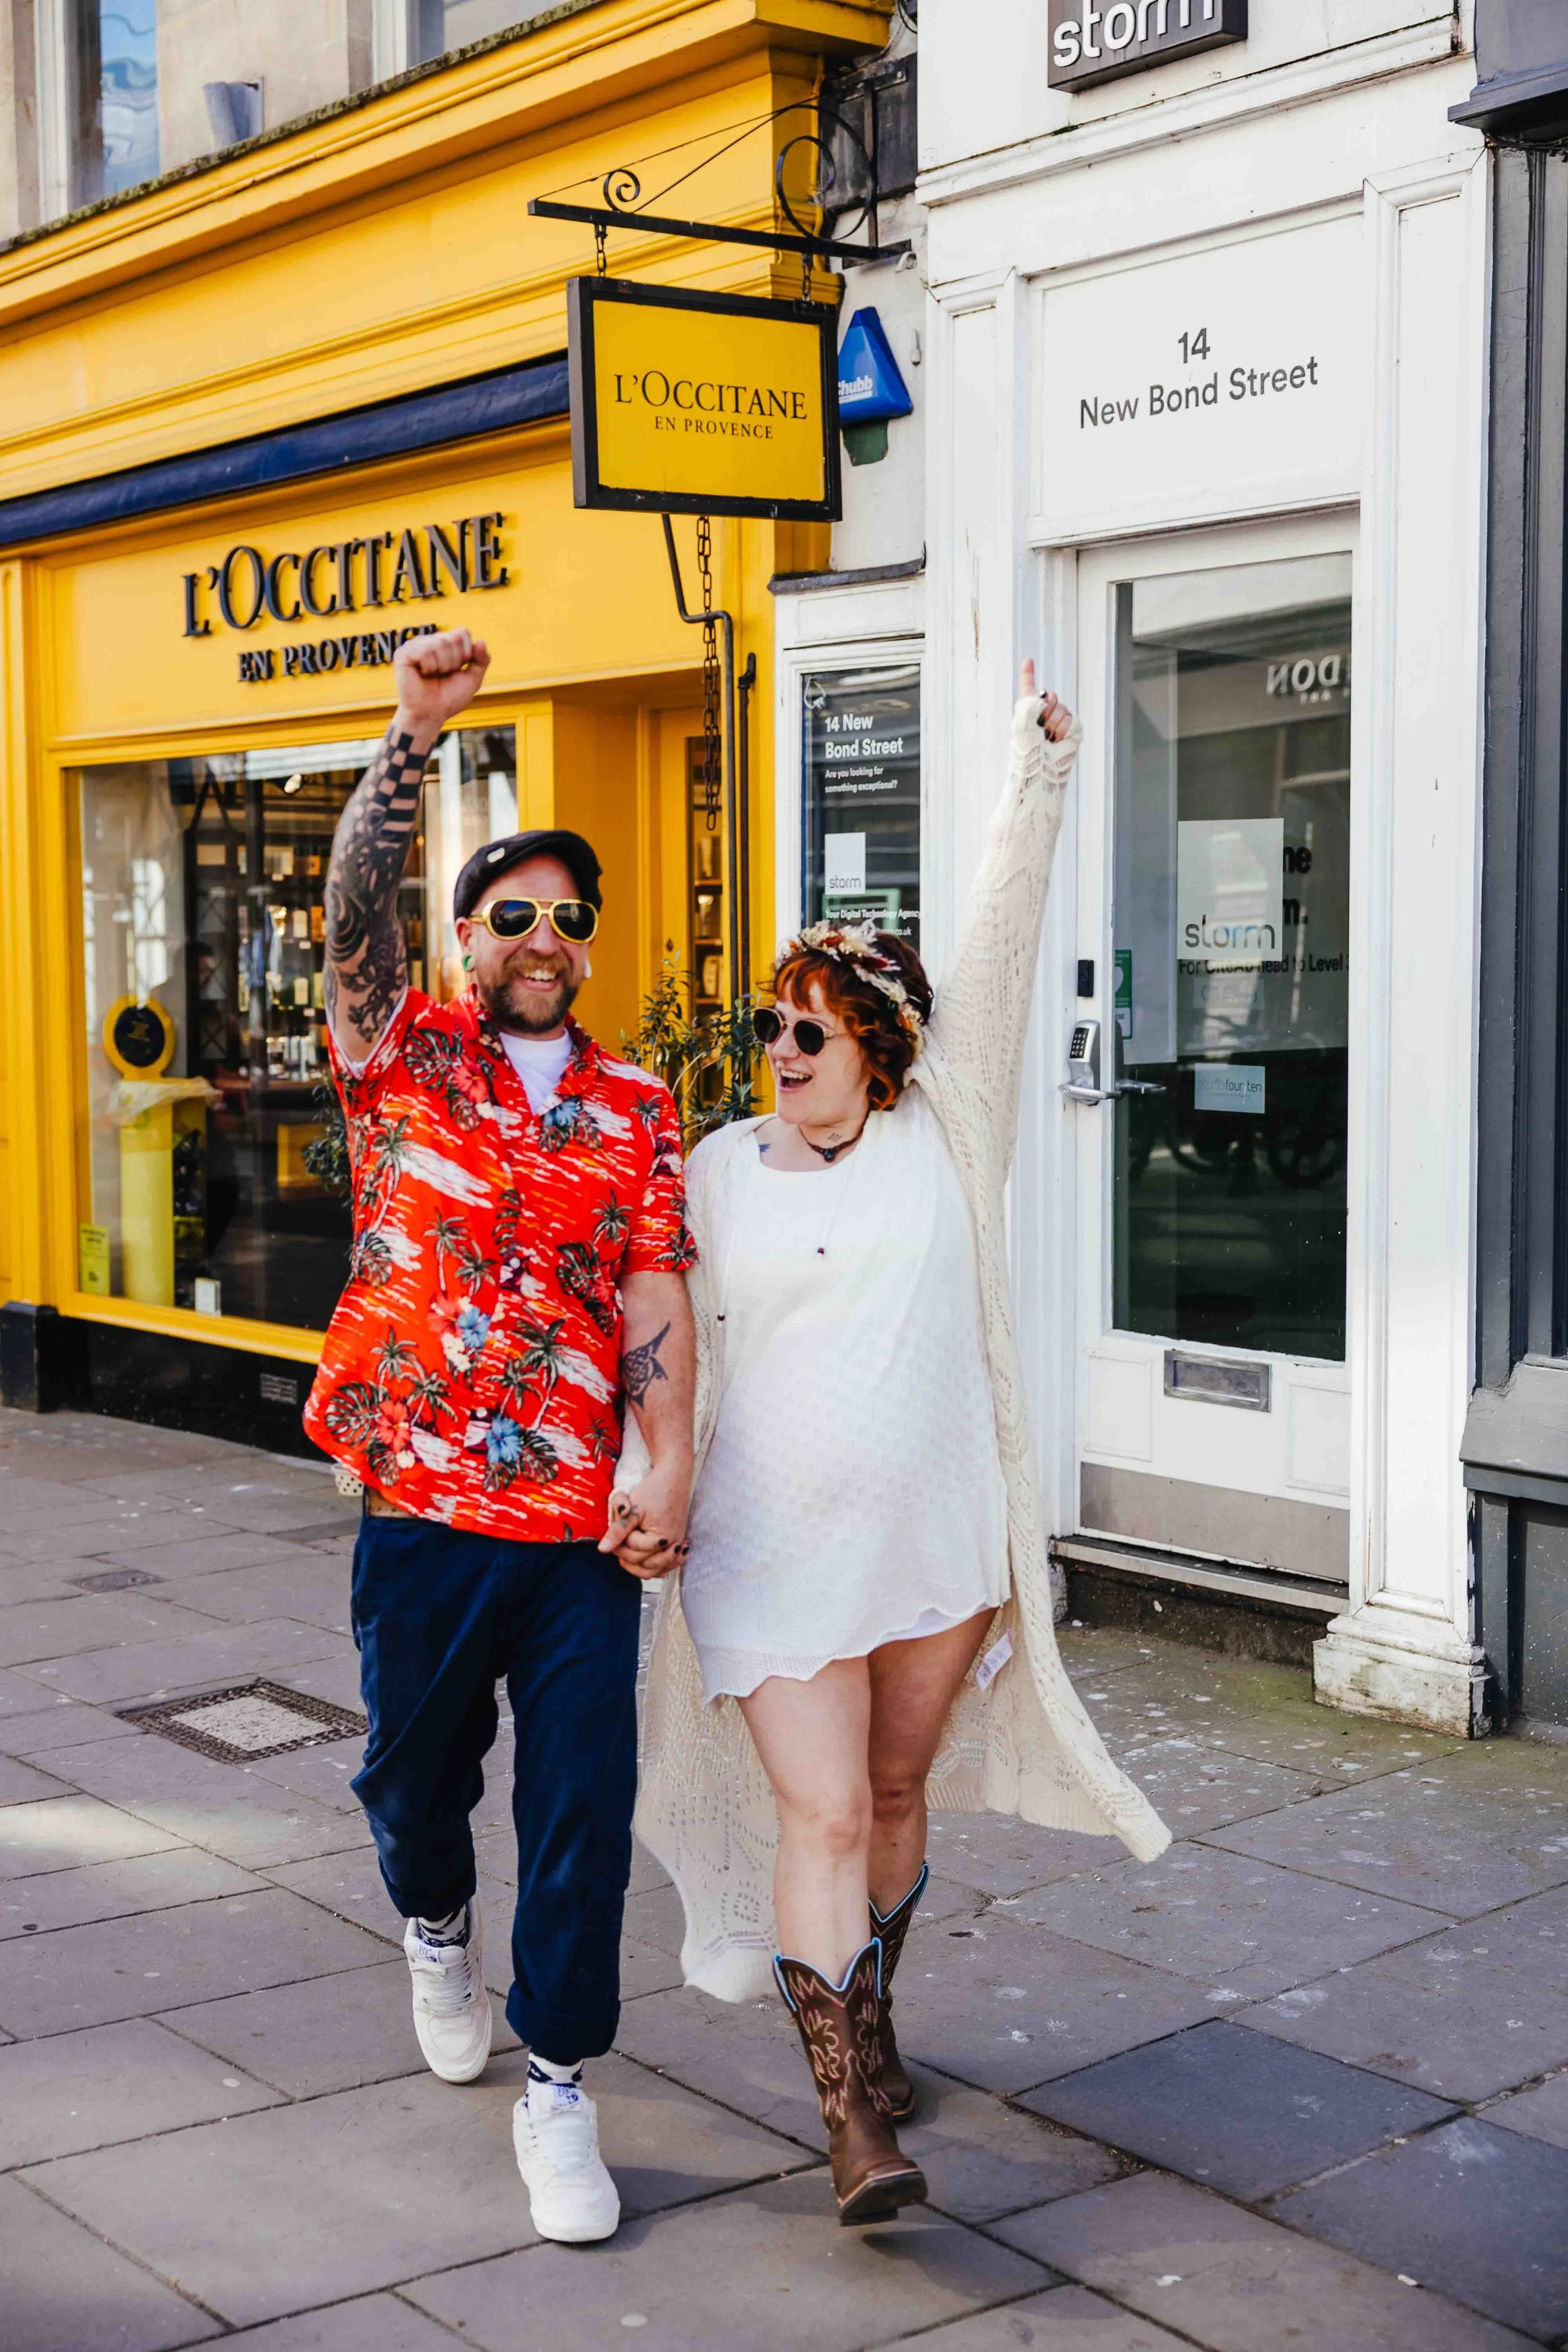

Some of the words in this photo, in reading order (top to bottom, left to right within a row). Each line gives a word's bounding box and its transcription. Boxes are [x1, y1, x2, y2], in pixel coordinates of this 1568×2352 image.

[1053, 0, 1214, 67] storm
[1178, 327, 1210, 364] 14
[614, 370, 808, 420] L'OCCITANE
[1080, 396, 1139, 429] New
[1150, 372, 1218, 416] Bond
[1229, 356, 1318, 400] Street
[655, 416, 676, 431] EN
[684, 418, 773, 439] PROVENCE
[181, 512, 509, 637] L'OCCITANE
[238, 650, 274, 683] EN
[282, 623, 437, 676] PROVEN
[825, 716, 840, 733] 14
[842, 713, 874, 731] New
[825, 738, 859, 759] Bond
[862, 737, 903, 756] Street
[825, 770, 837, 778] Are
[837, 770, 849, 779] you
[849, 768, 873, 777] looking
[874, 766, 884, 775] for
[825, 782, 857, 793] something
[858, 779, 898, 792] exceptional?
[829, 875, 861, 888] storm
[1185, 914, 1275, 949] storm
[1179, 960, 1200, 975] For
[1309, 953, 1343, 972] Level
[1248, 1079, 1262, 1092] ten
